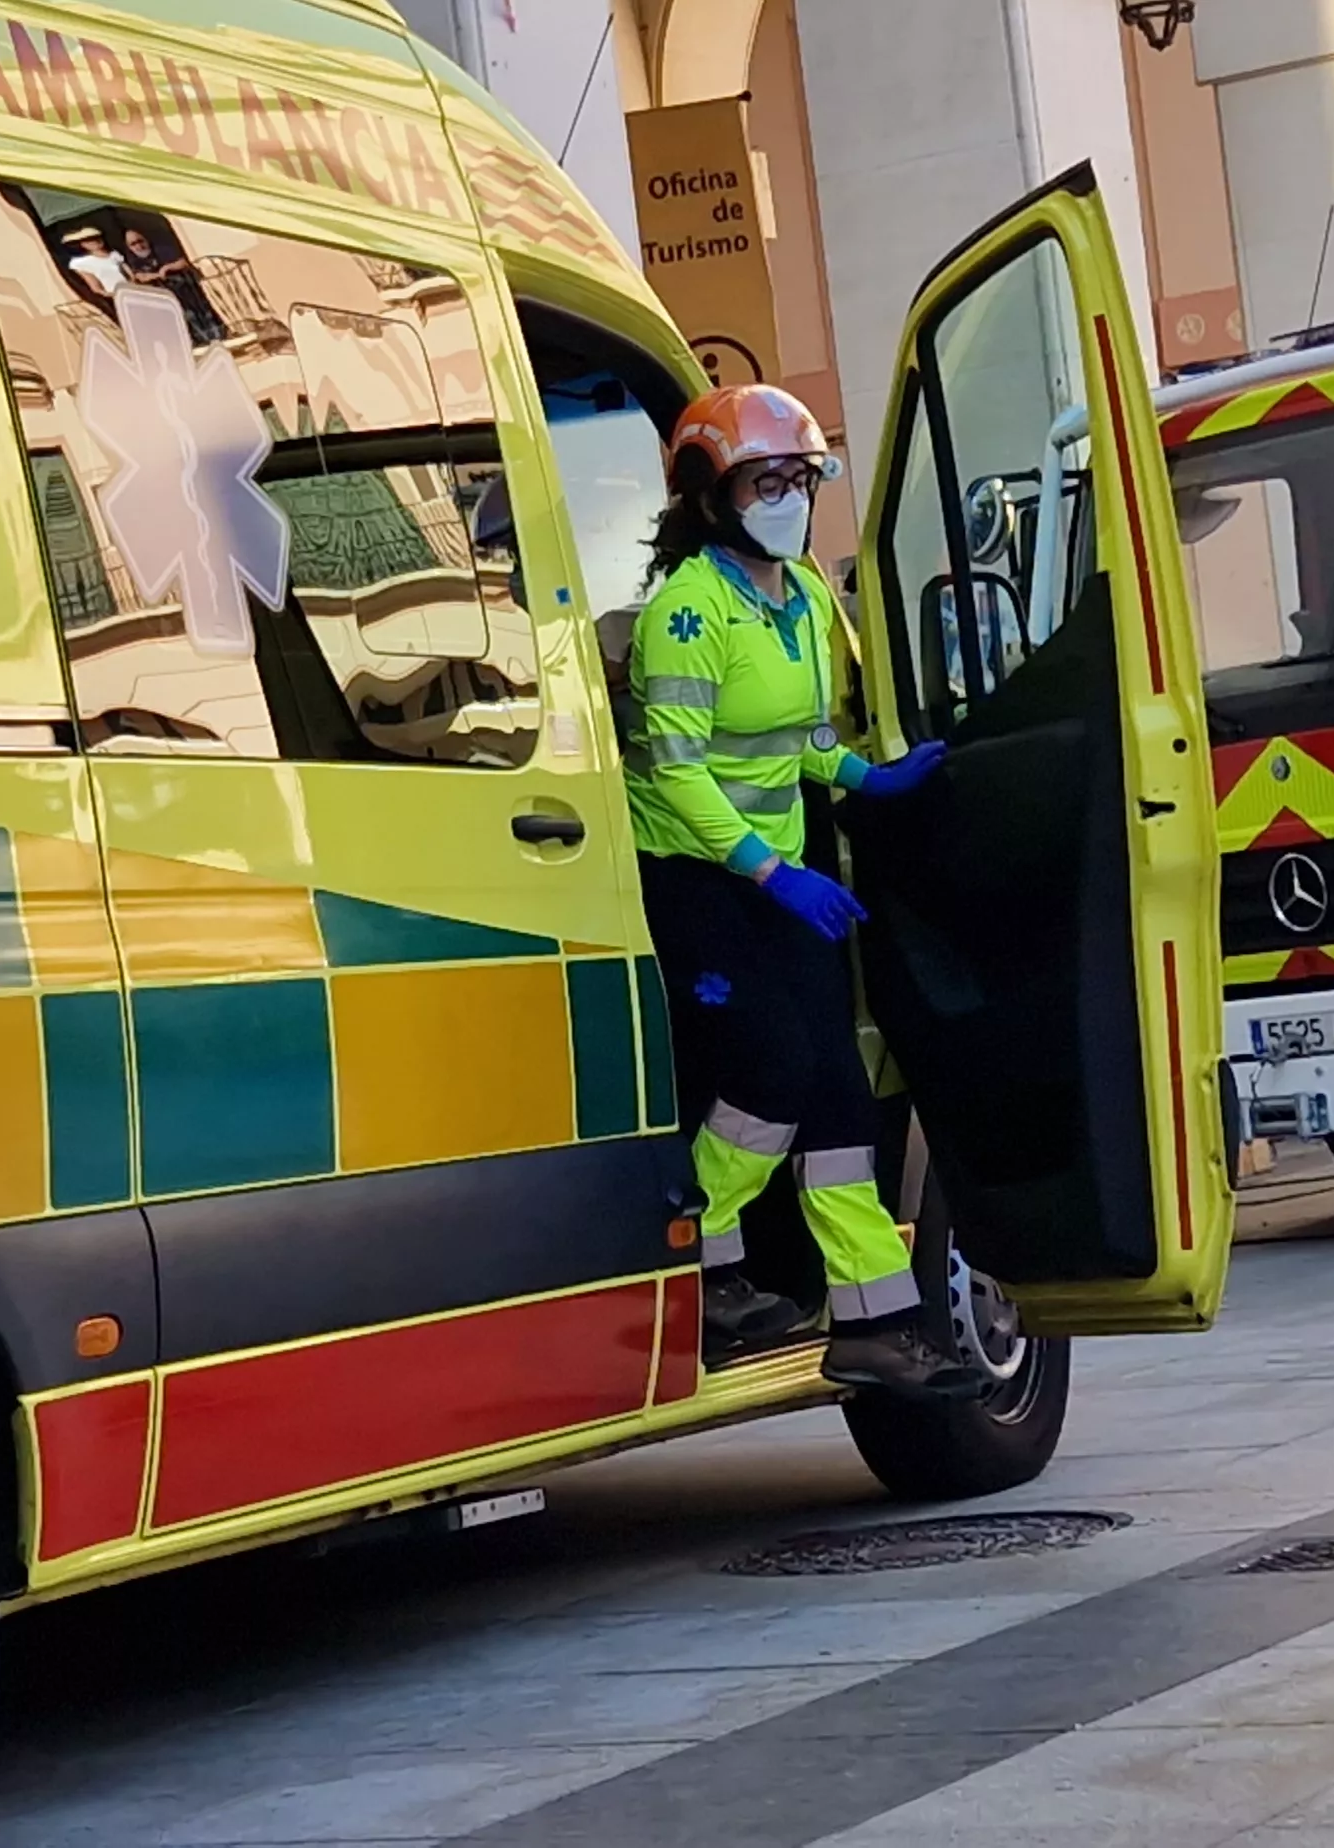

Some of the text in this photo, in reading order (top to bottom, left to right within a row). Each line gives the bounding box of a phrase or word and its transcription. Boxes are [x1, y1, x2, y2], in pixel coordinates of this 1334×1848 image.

[648, 167, 738, 200] Oficina
[712, 198, 744, 223] de
[643, 234, 749, 265] Turismo
